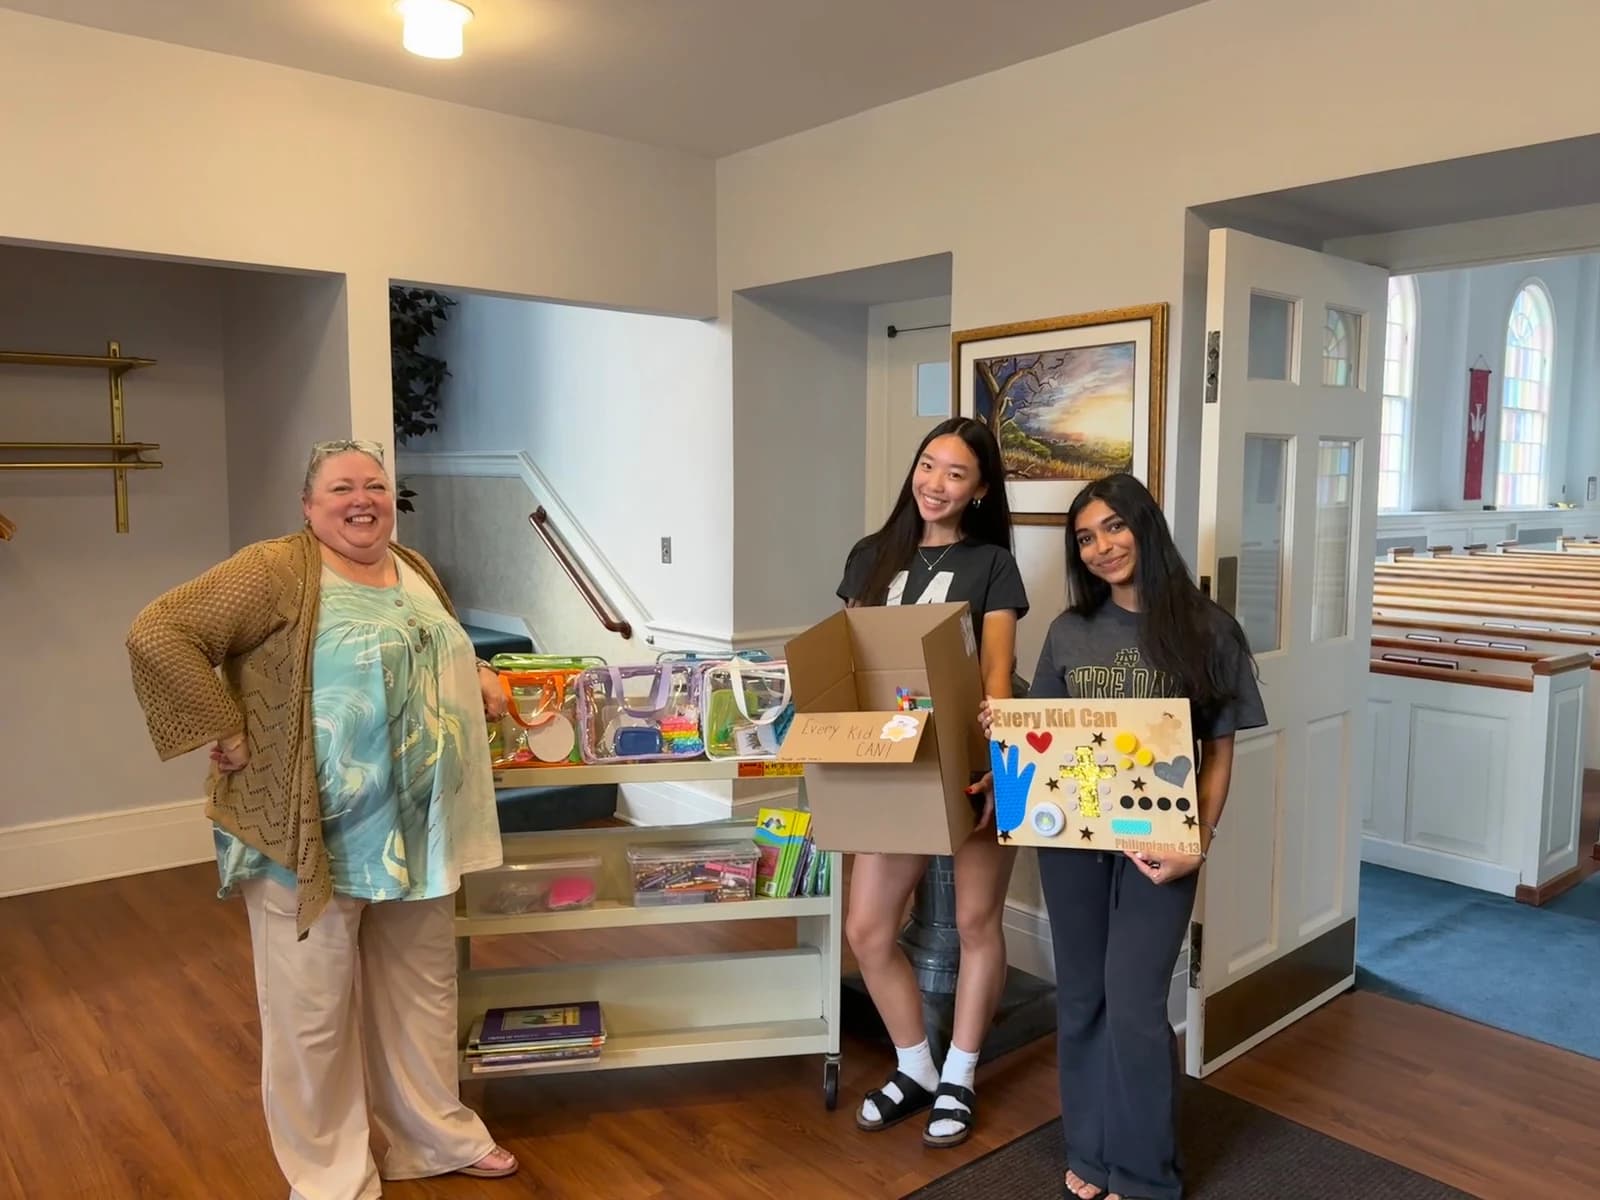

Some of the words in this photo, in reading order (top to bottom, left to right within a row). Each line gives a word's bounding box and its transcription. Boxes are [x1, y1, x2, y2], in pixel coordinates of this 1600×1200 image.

[801, 718, 840, 740] Every
[847, 726, 874, 740] Kid
[993, 708, 1042, 729] Every
[1045, 708, 1076, 728] Kid
[1079, 708, 1118, 728] Can
